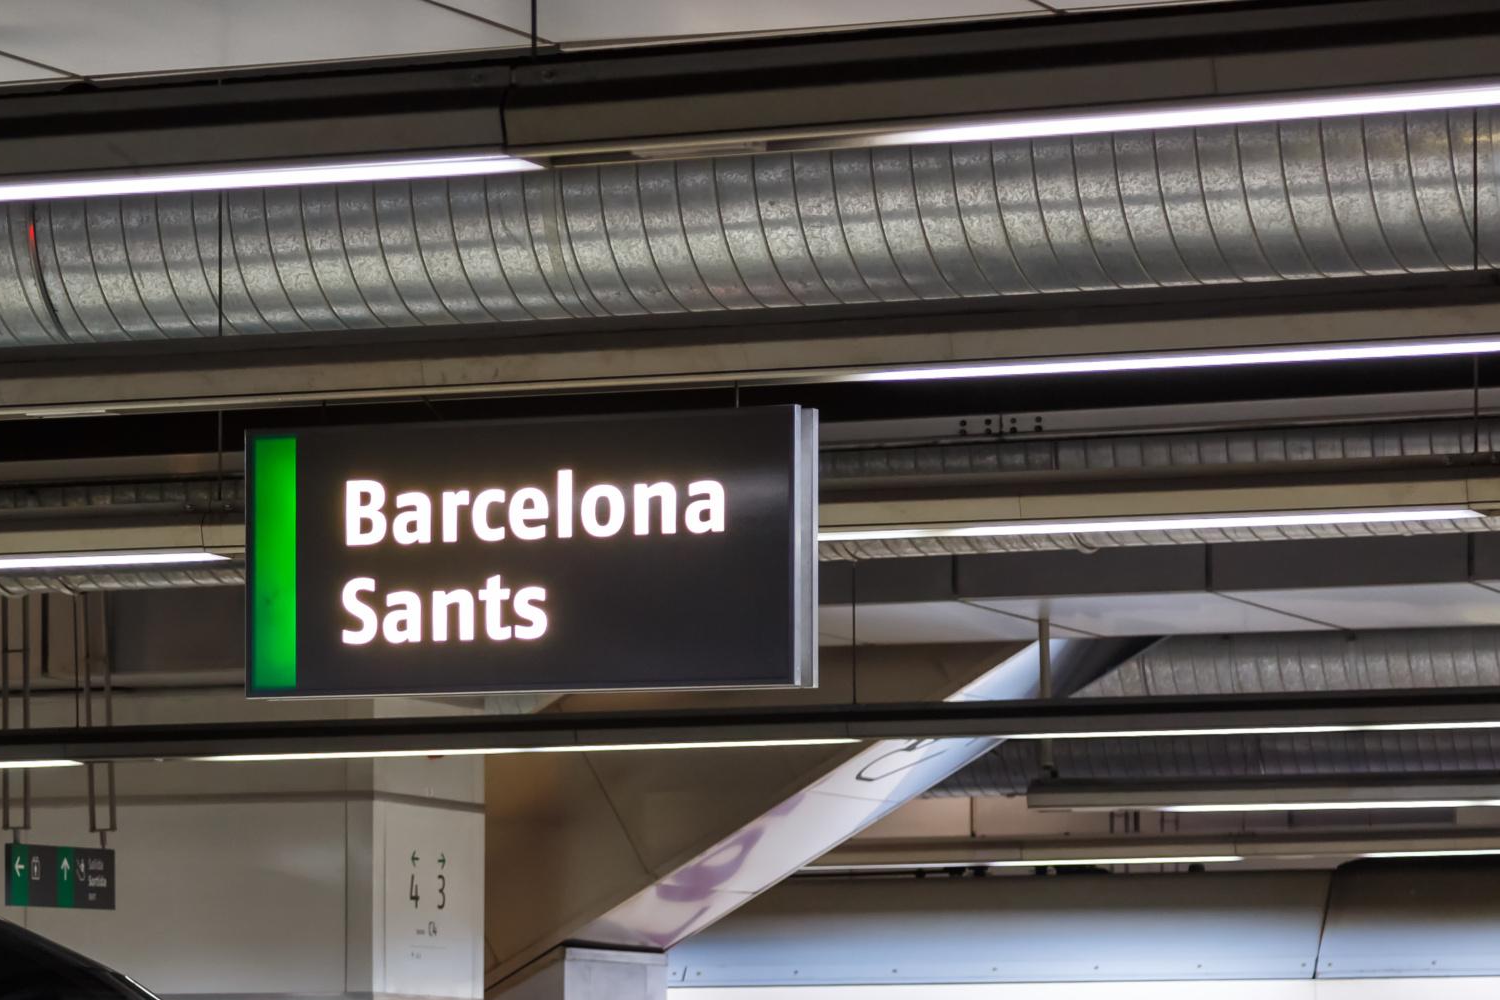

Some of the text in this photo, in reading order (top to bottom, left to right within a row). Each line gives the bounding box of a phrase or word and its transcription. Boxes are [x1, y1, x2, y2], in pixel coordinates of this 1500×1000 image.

[345, 468, 726, 547] Barcelona
[341, 574, 549, 645] Sants
[409, 874, 446, 909] 4 3
